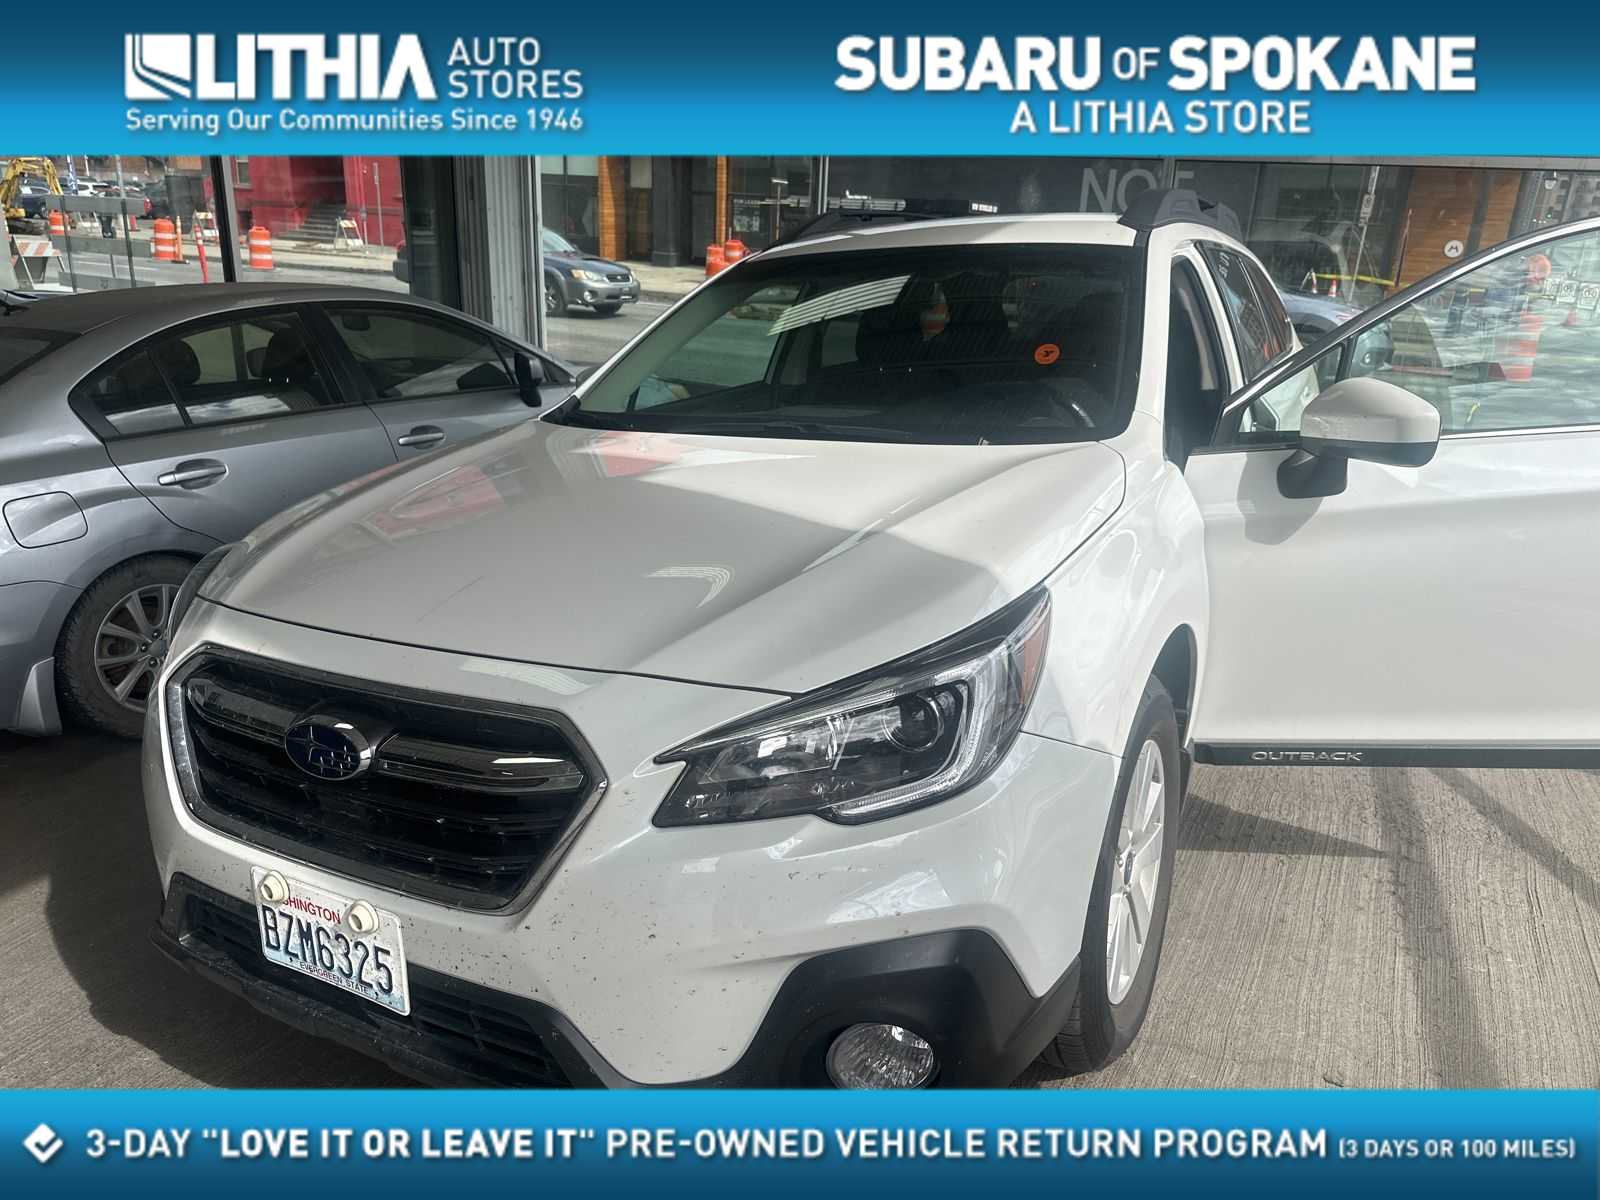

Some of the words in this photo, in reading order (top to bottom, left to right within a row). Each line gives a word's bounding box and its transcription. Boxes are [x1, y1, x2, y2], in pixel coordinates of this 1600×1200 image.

[1251, 751, 1363, 761] OUTBACK
[282, 896, 342, 924] HINGTON
[261, 904, 394, 994] BZM6325
[300, 961, 343, 984] EVERGREEN
[346, 978, 369, 994] STATE
